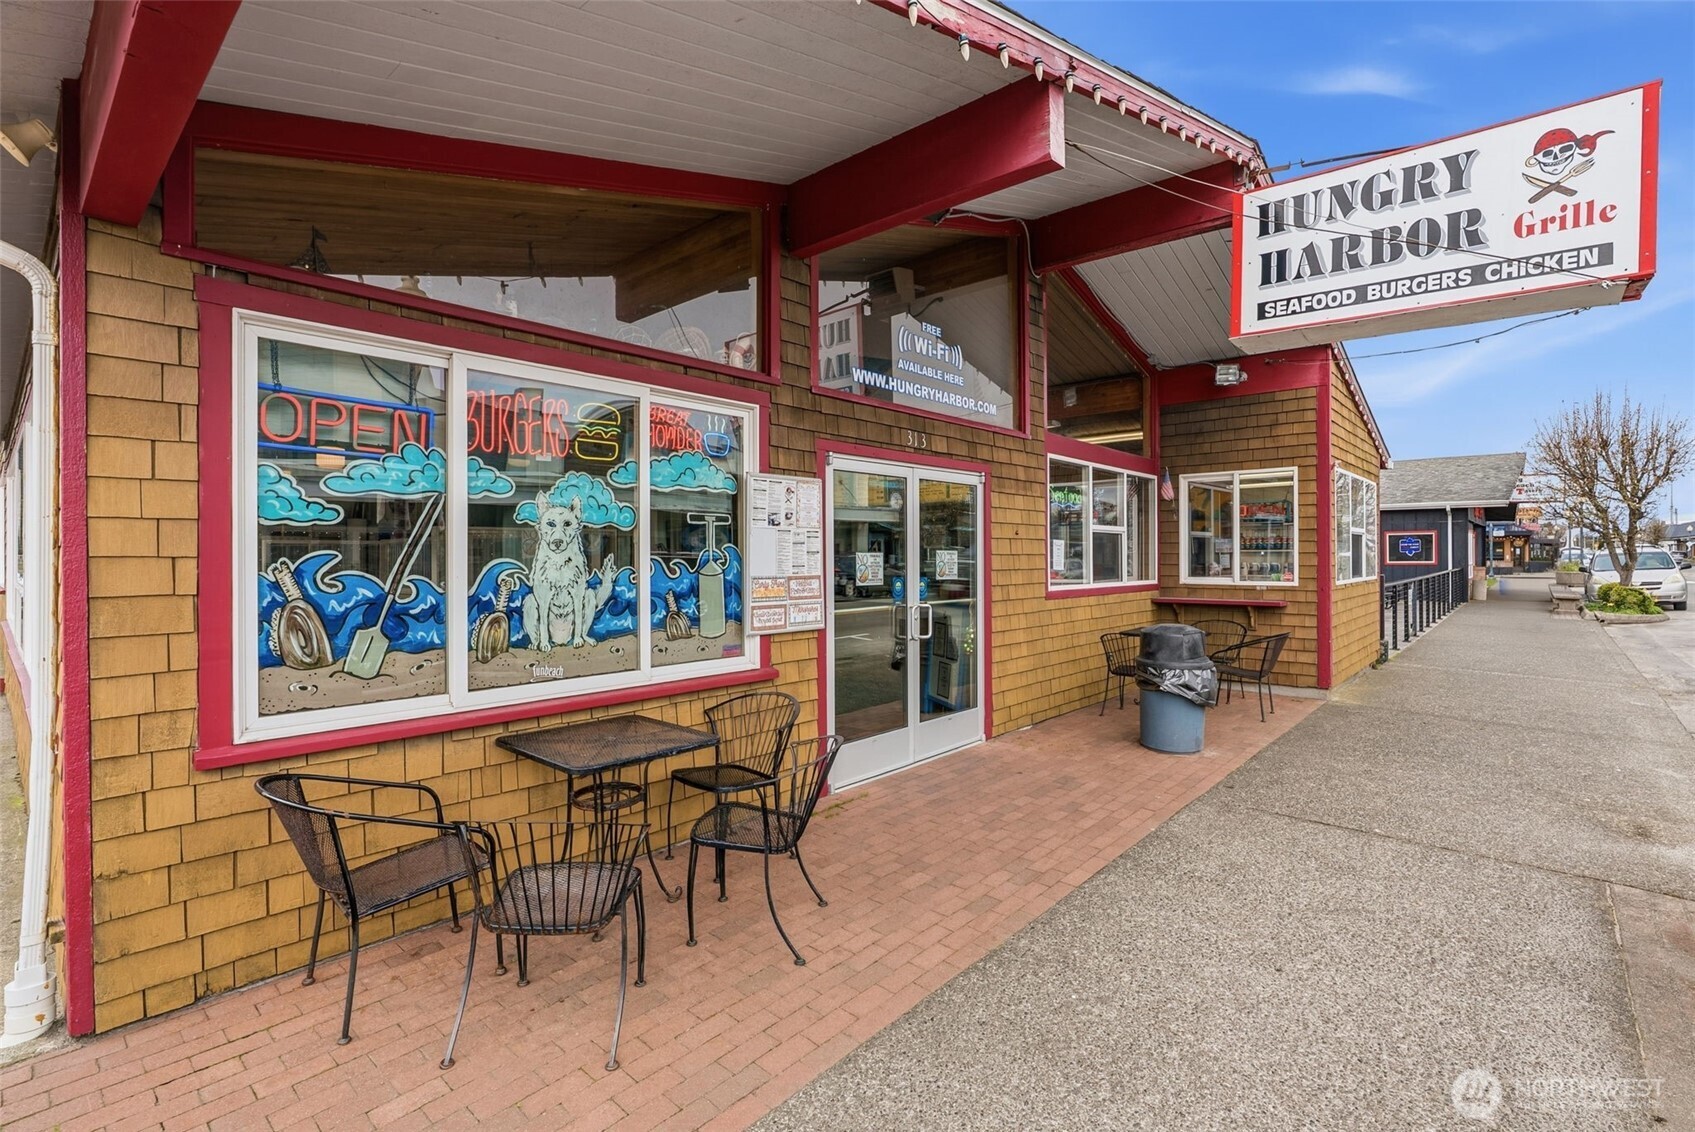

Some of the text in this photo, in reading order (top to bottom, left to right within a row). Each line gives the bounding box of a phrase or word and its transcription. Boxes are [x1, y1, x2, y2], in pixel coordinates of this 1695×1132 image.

[1257, 149, 1480, 239] HUNGRY
[1513, 199, 1618, 239] Grille
[1258, 207, 1489, 288] HARBOR
[1264, 247, 1599, 318] SEAFOOD BURGERS CHICKEN
[914, 335, 951, 362] Wi-Fi
[922, 322, 942, 337] FREE
[852, 367, 997, 416] WWW.HUNGRYHARBOR.COM
[898, 359, 964, 386] AVAILABLE HERE
[260, 392, 427, 453] OPEN
[467, 389, 569, 457] BURGERS
[907, 430, 926, 449] 313
